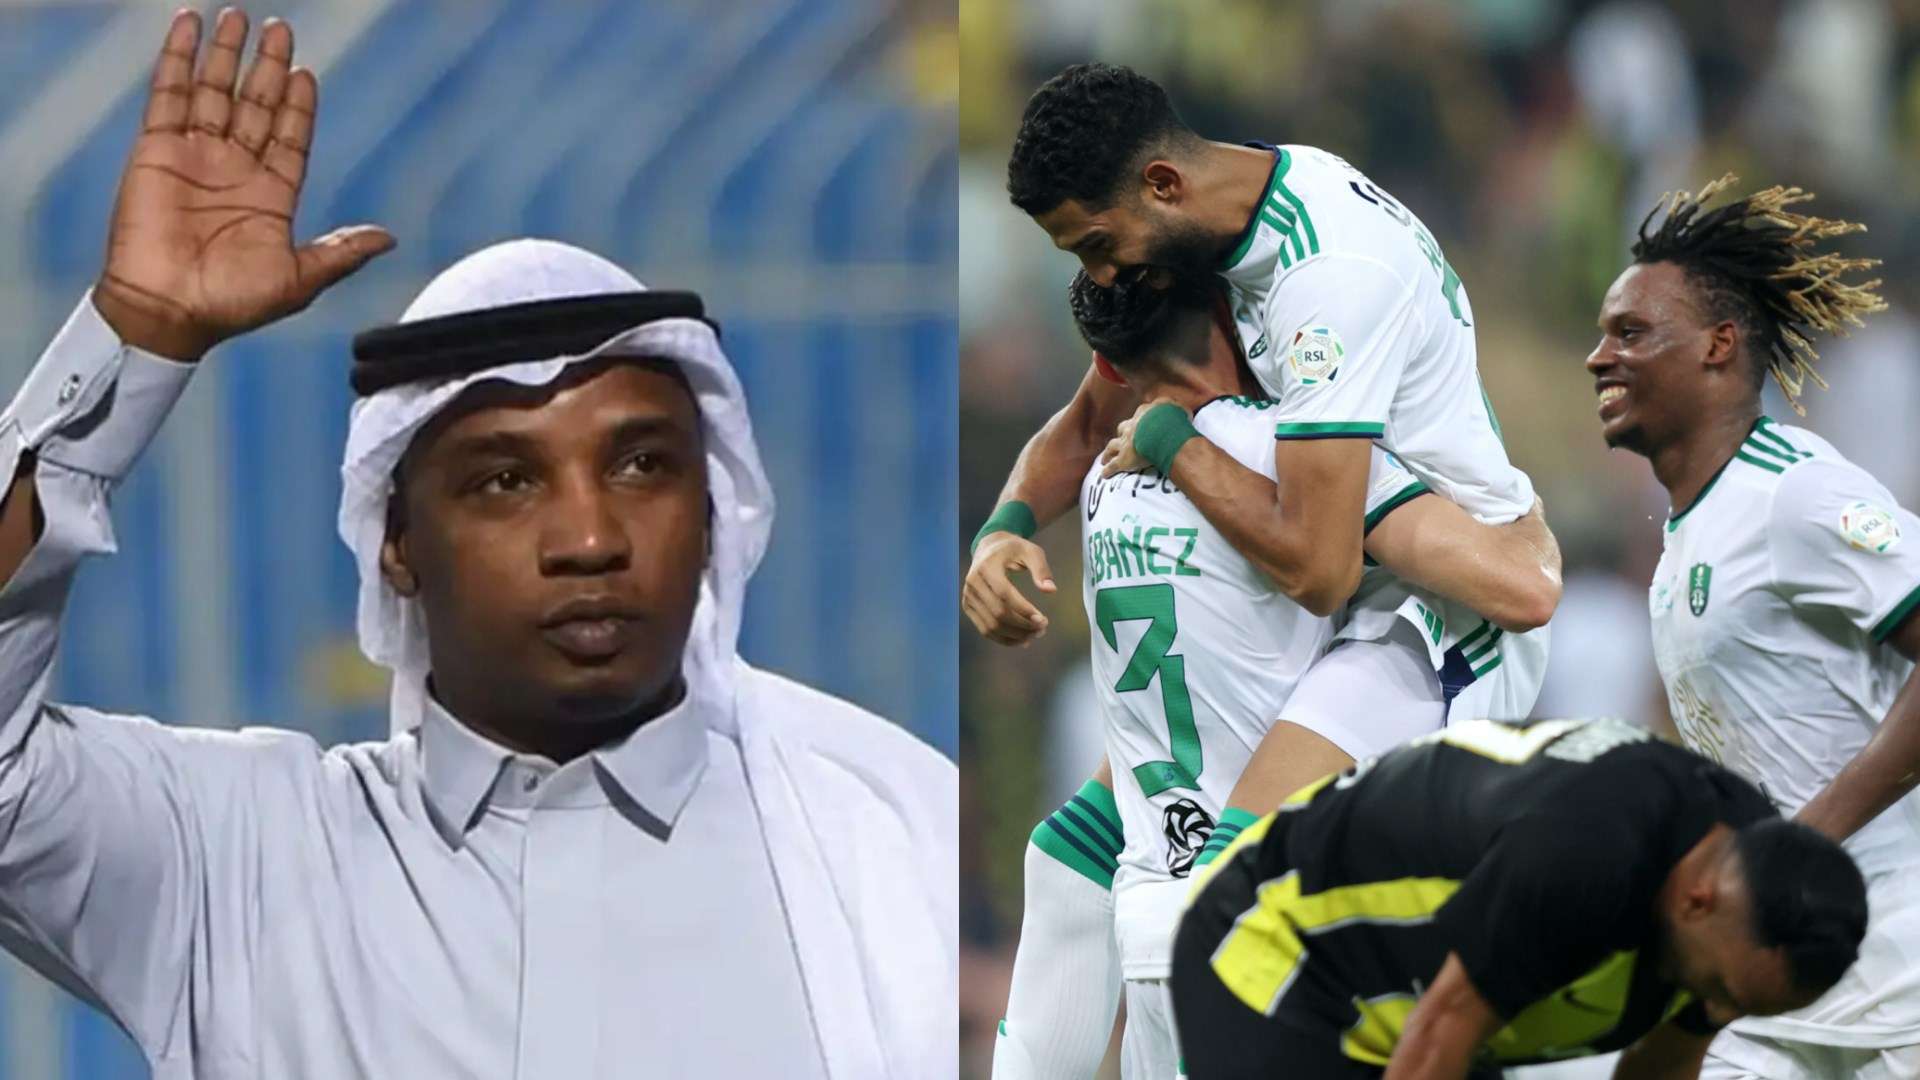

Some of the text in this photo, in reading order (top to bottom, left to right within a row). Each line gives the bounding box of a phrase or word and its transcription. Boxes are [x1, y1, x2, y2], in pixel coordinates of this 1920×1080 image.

[1304, 350, 1327, 362] RSL
[1861, 518, 1883, 534] RSL
[1096, 583, 1204, 799] 3
